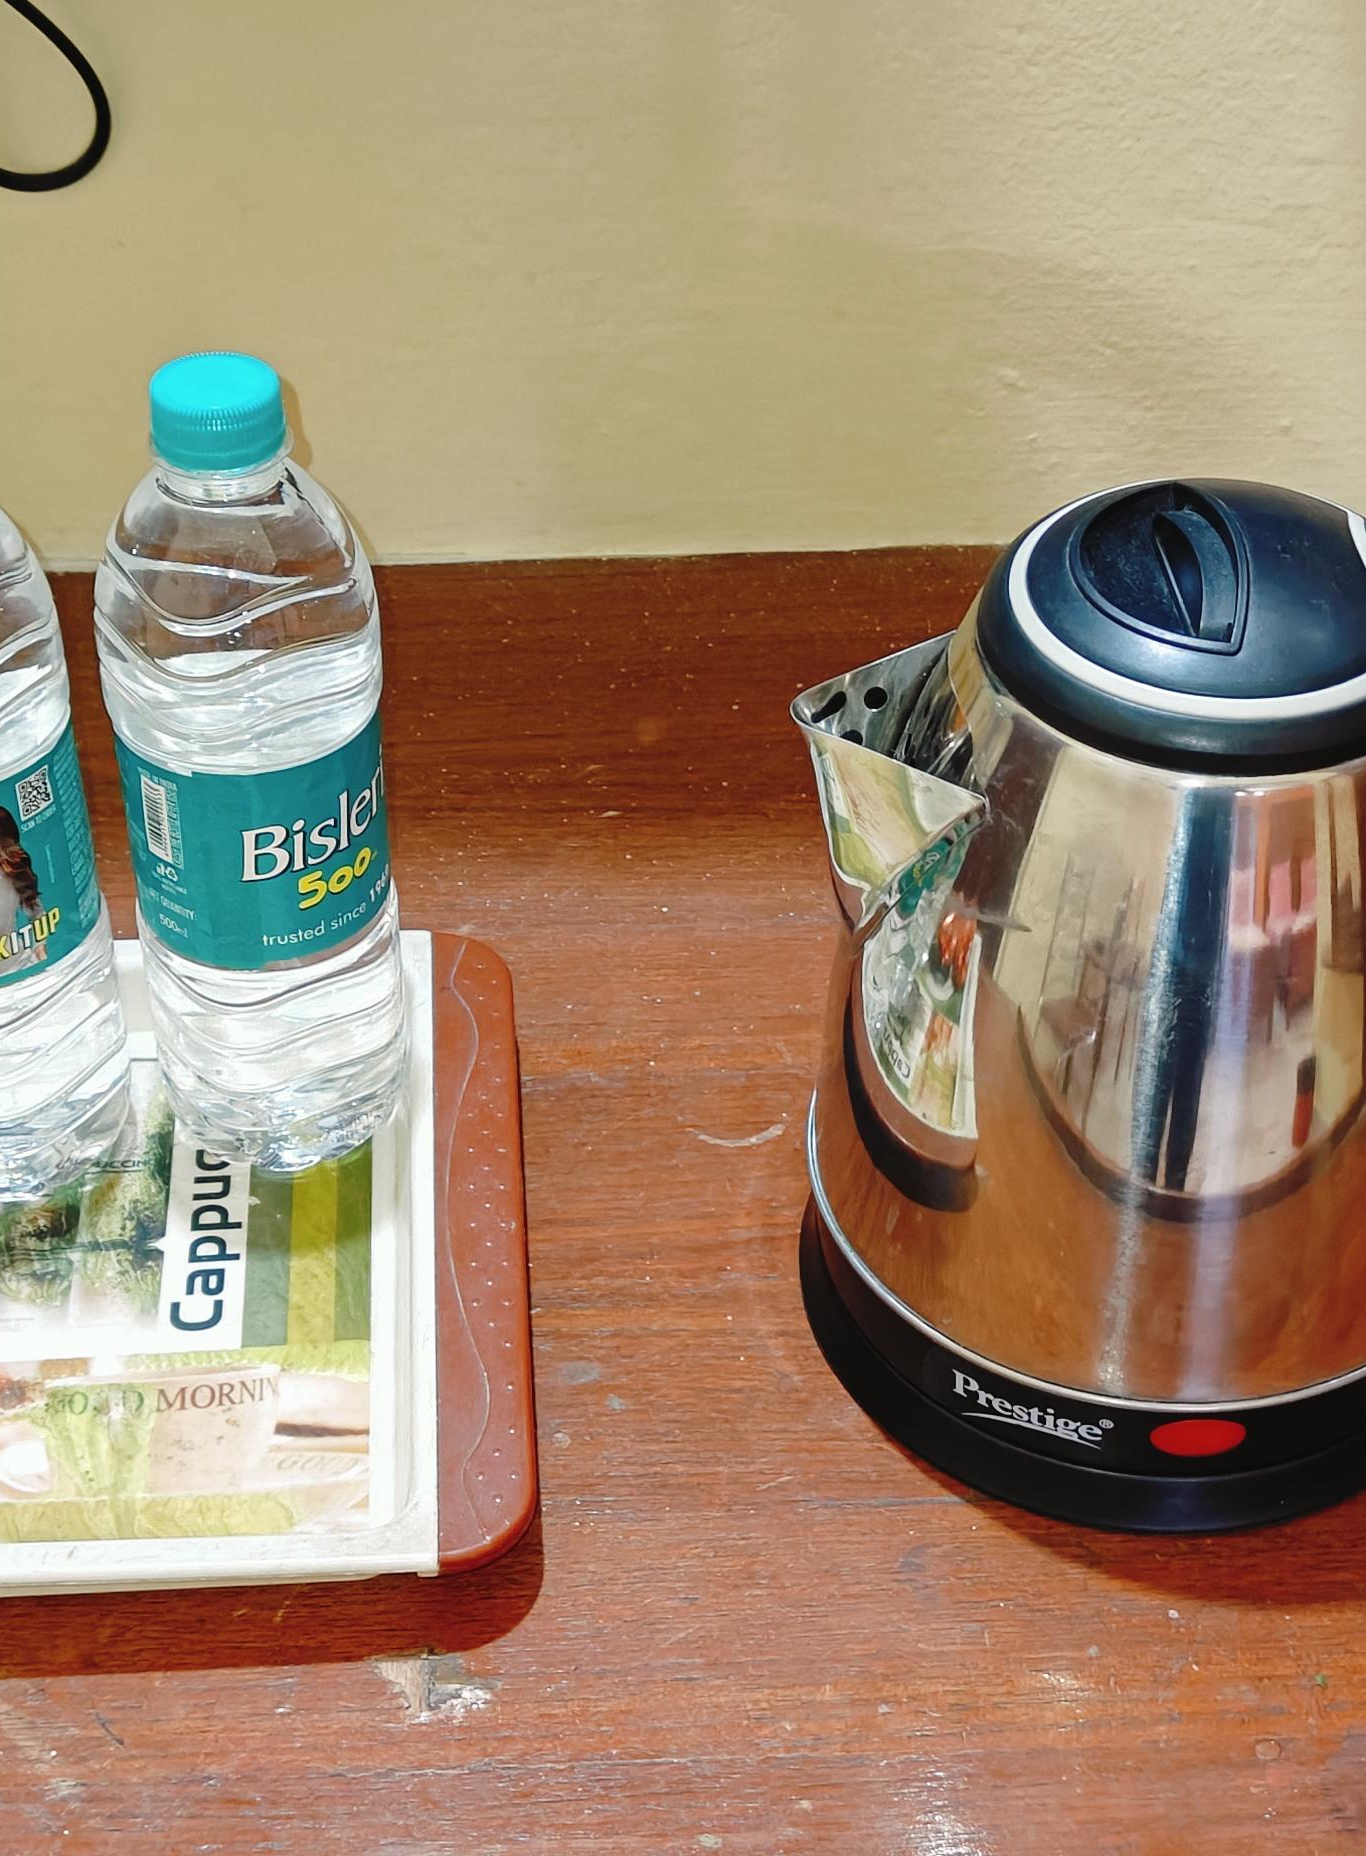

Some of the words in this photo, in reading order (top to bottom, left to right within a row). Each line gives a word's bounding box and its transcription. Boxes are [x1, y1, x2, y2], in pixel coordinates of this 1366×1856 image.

[298, 847, 372, 910] 500
[262, 920, 326, 947] trusted
[331, 902, 366, 930] since
[951, 1368, 1104, 1441] Prestige
